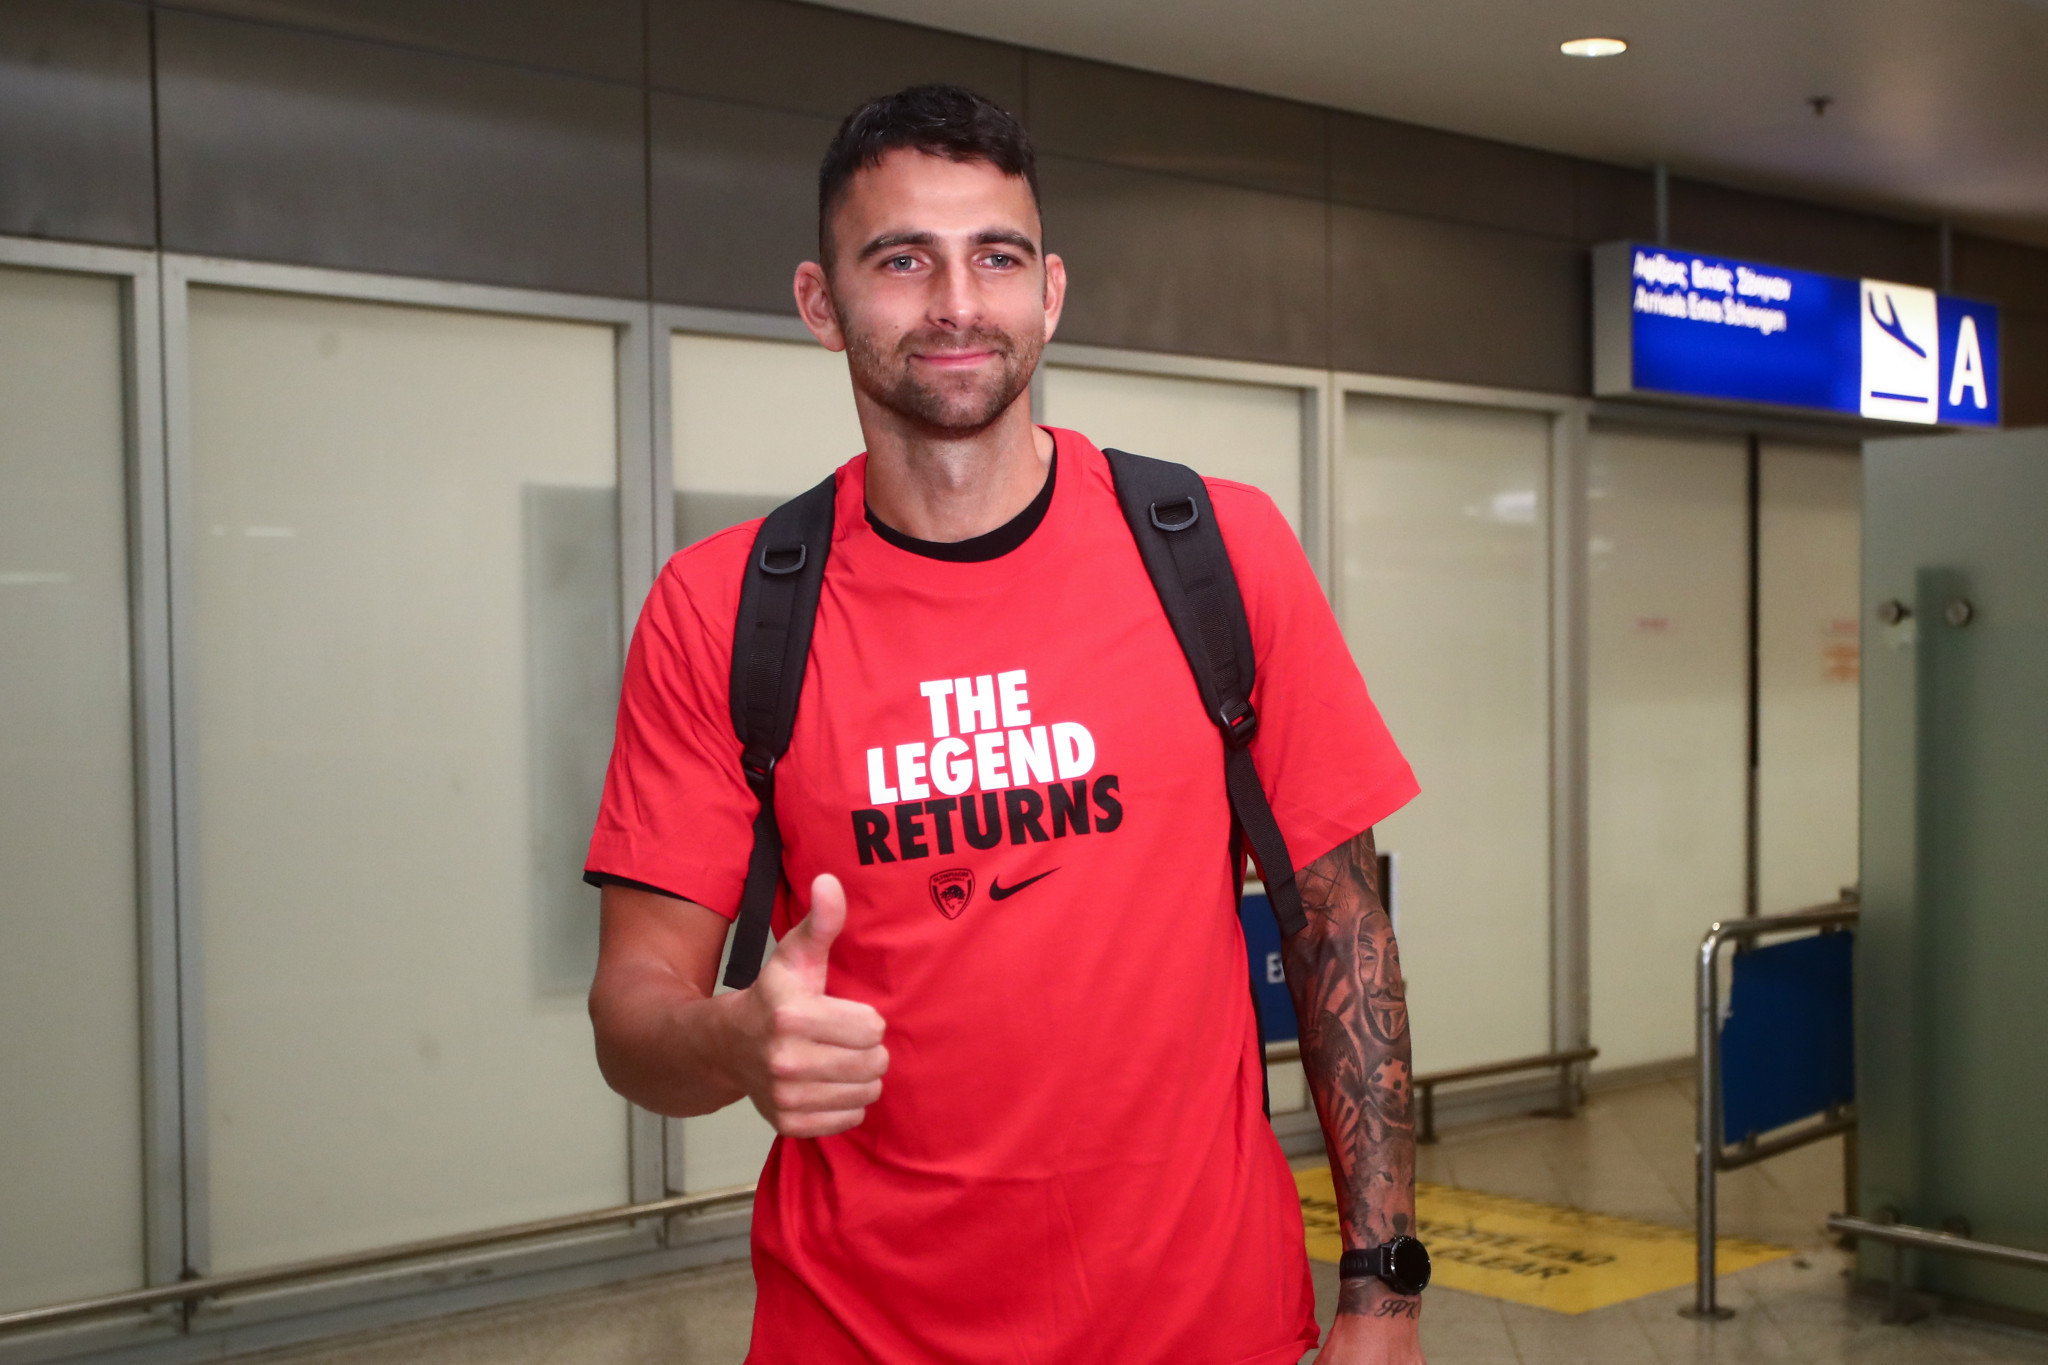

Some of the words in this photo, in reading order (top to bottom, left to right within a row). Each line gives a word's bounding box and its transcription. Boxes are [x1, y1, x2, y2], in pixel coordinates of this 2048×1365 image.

[1948, 315, 1988, 409] A
[919, 669, 1032, 738] THE
[866, 721, 1096, 805] LEGEND
[851, 774, 1124, 865] RETURNS
